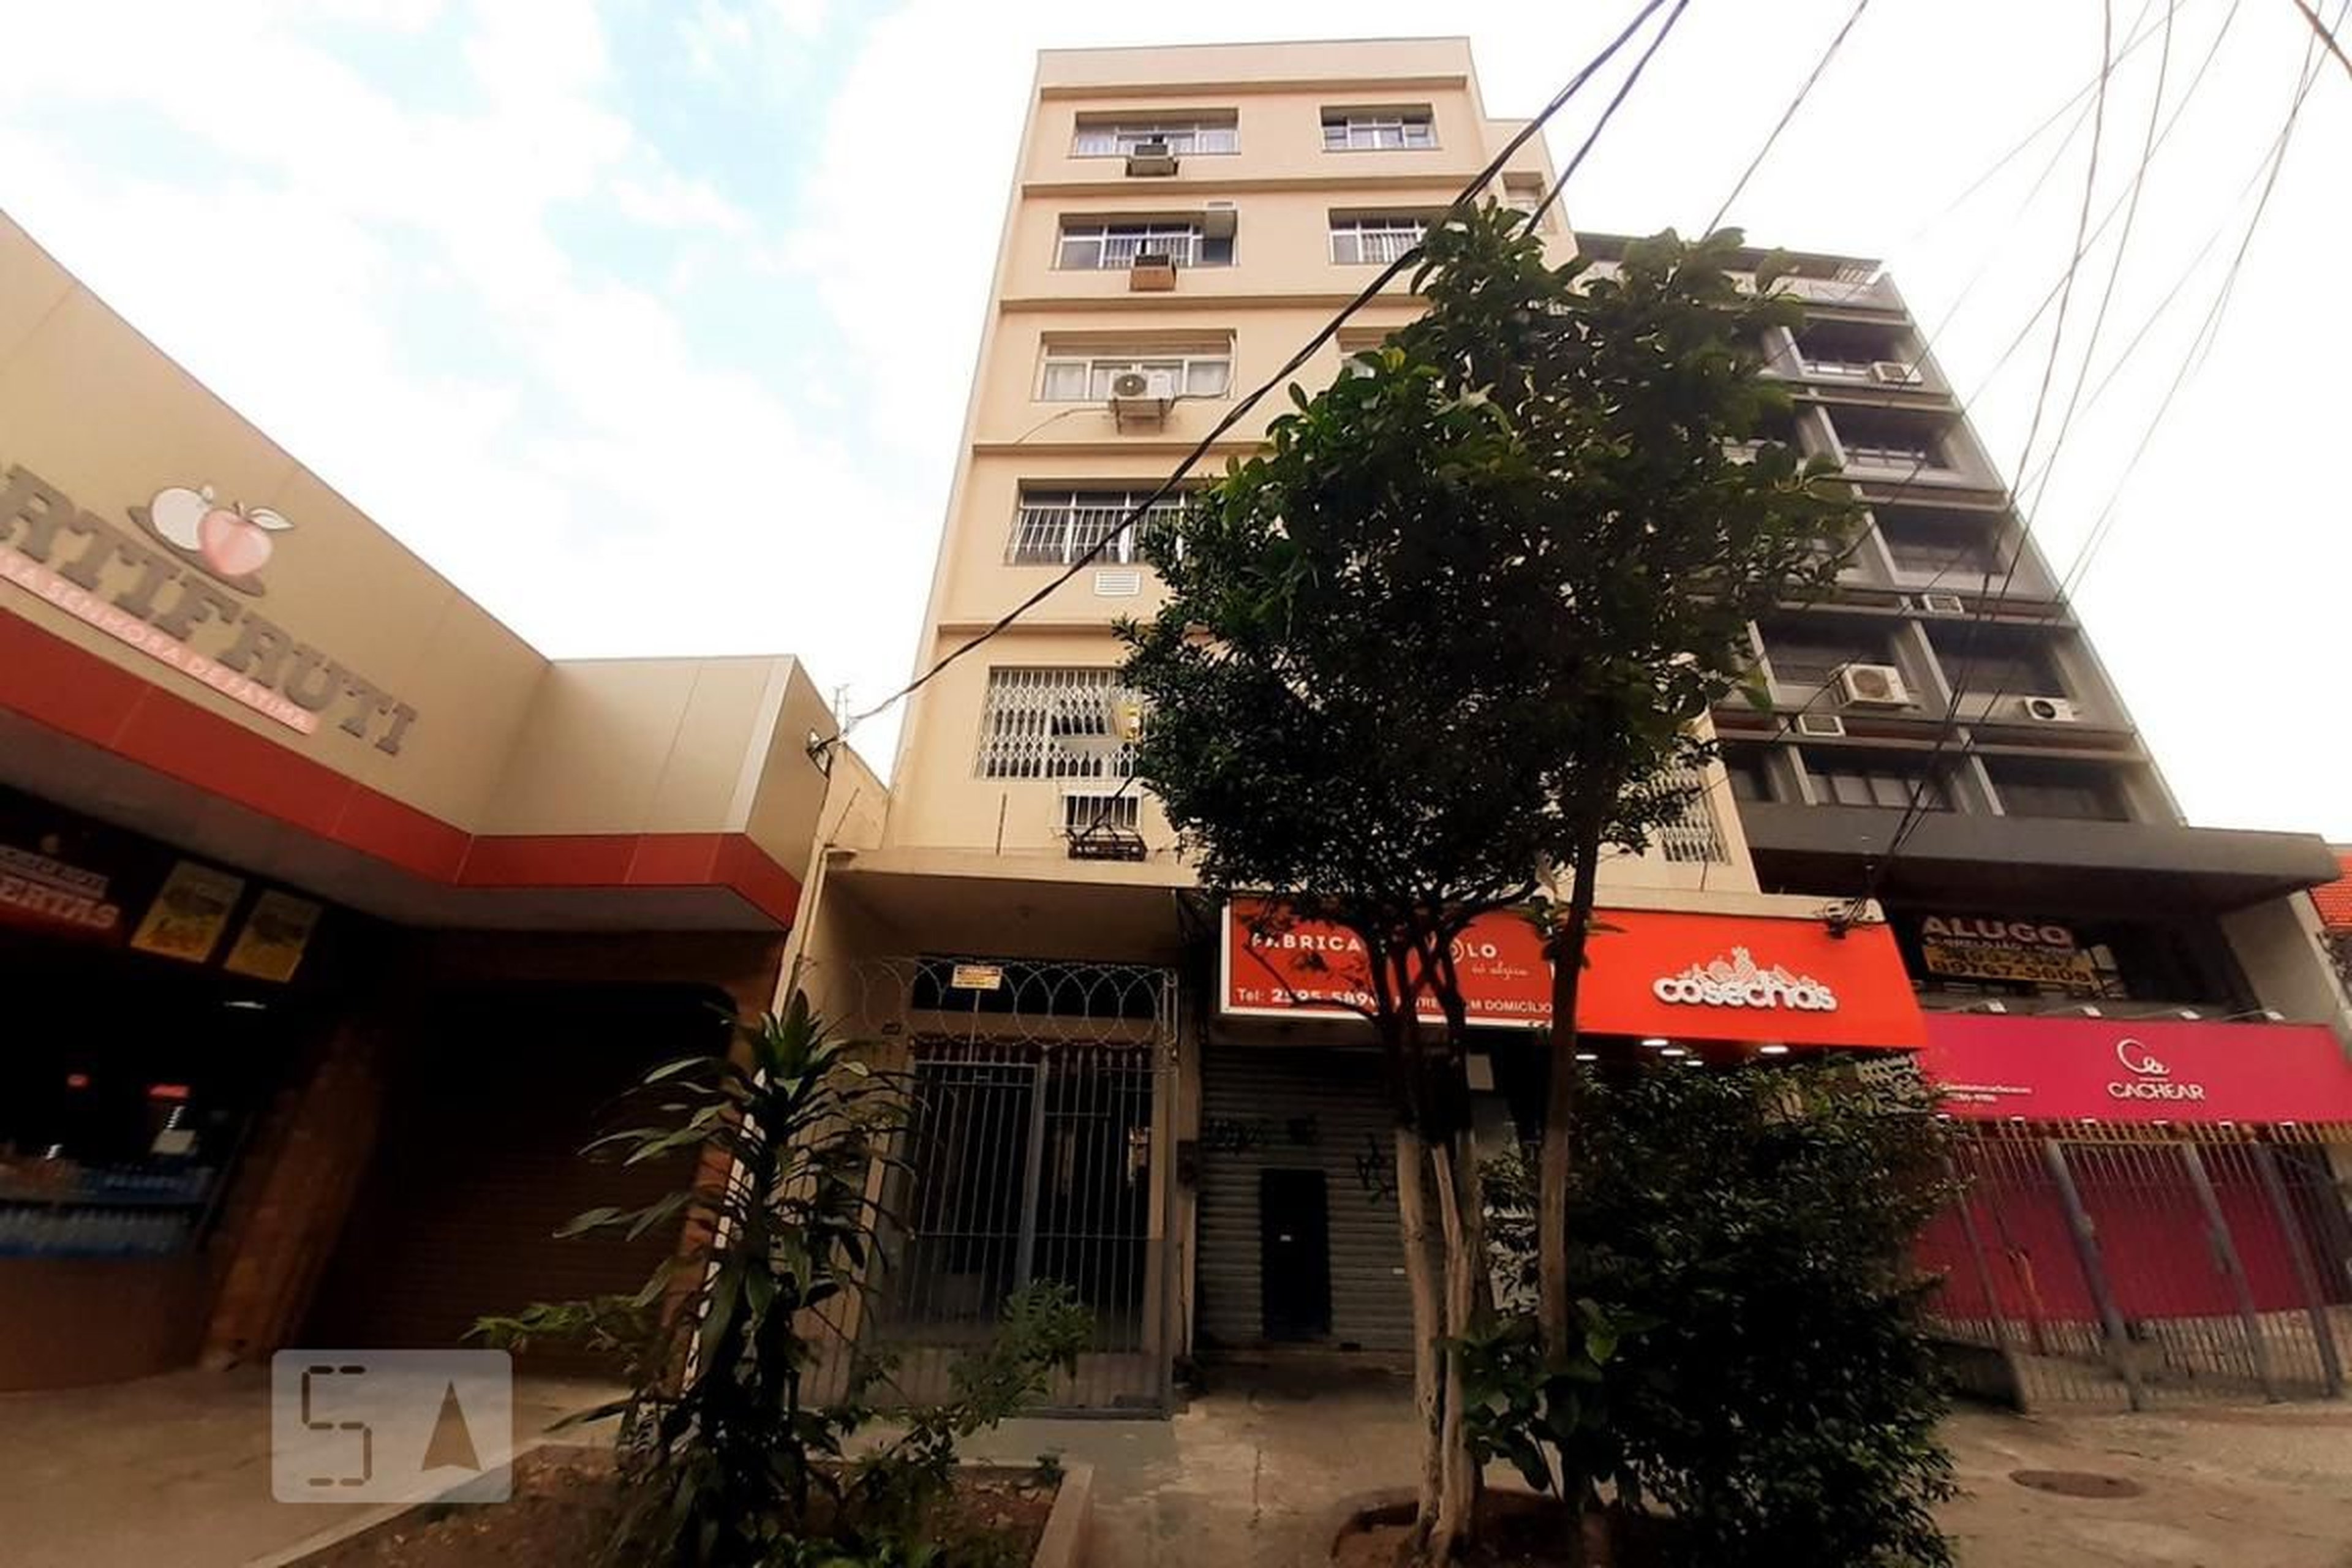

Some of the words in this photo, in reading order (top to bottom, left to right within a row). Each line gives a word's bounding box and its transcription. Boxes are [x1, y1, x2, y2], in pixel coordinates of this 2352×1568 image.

[1922, 916, 2075, 944] ALUGO
[1653, 971, 1837, 1010] cosechas
[2107, 1082, 2206, 1100] CACHEAR
